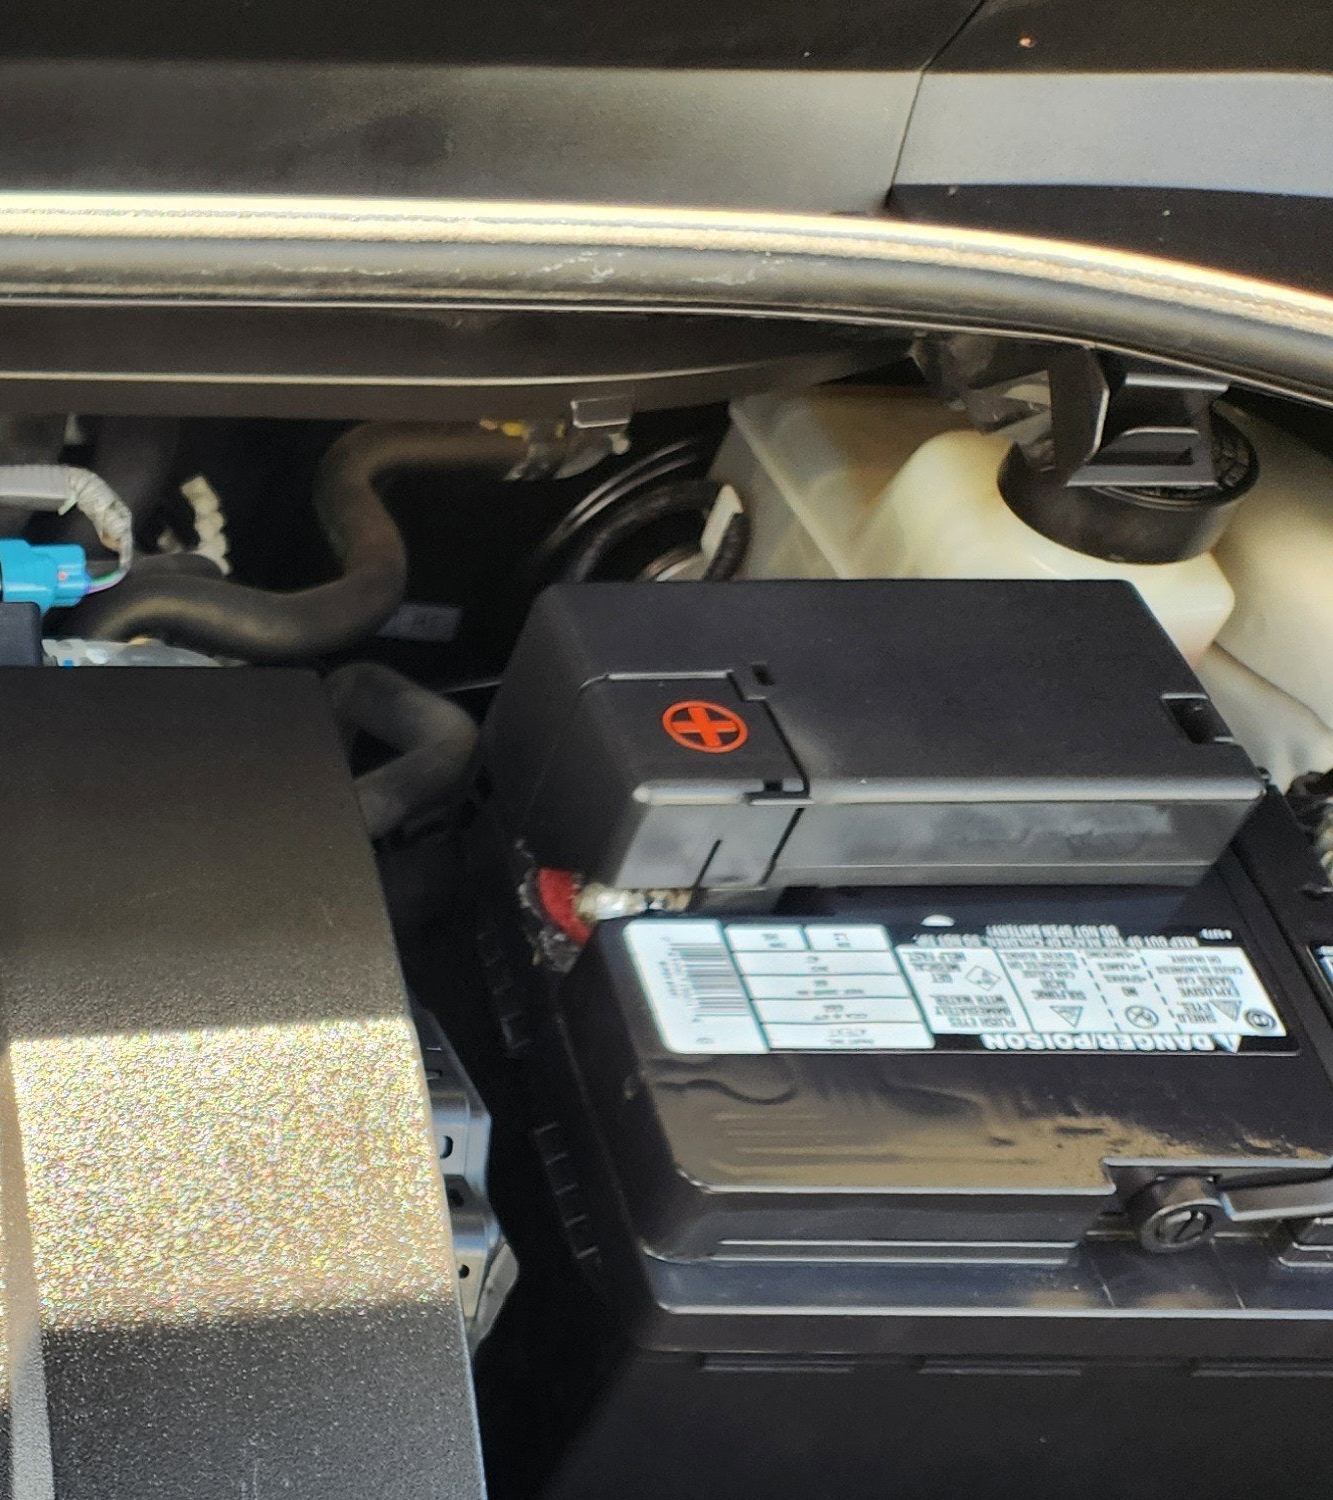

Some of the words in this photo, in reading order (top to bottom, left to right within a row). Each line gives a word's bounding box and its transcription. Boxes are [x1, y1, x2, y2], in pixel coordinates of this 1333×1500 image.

[1155, 966, 1212, 975] BLINDNESS
[1121, 987, 1138, 998] NO
[1178, 987, 1240, 997] EXPLOSIVE
[948, 1017, 978, 1027] EYES
[1177, 1015, 1216, 1023] SHIELD
[981, 1033, 1214, 1051] DANGER/POISON
